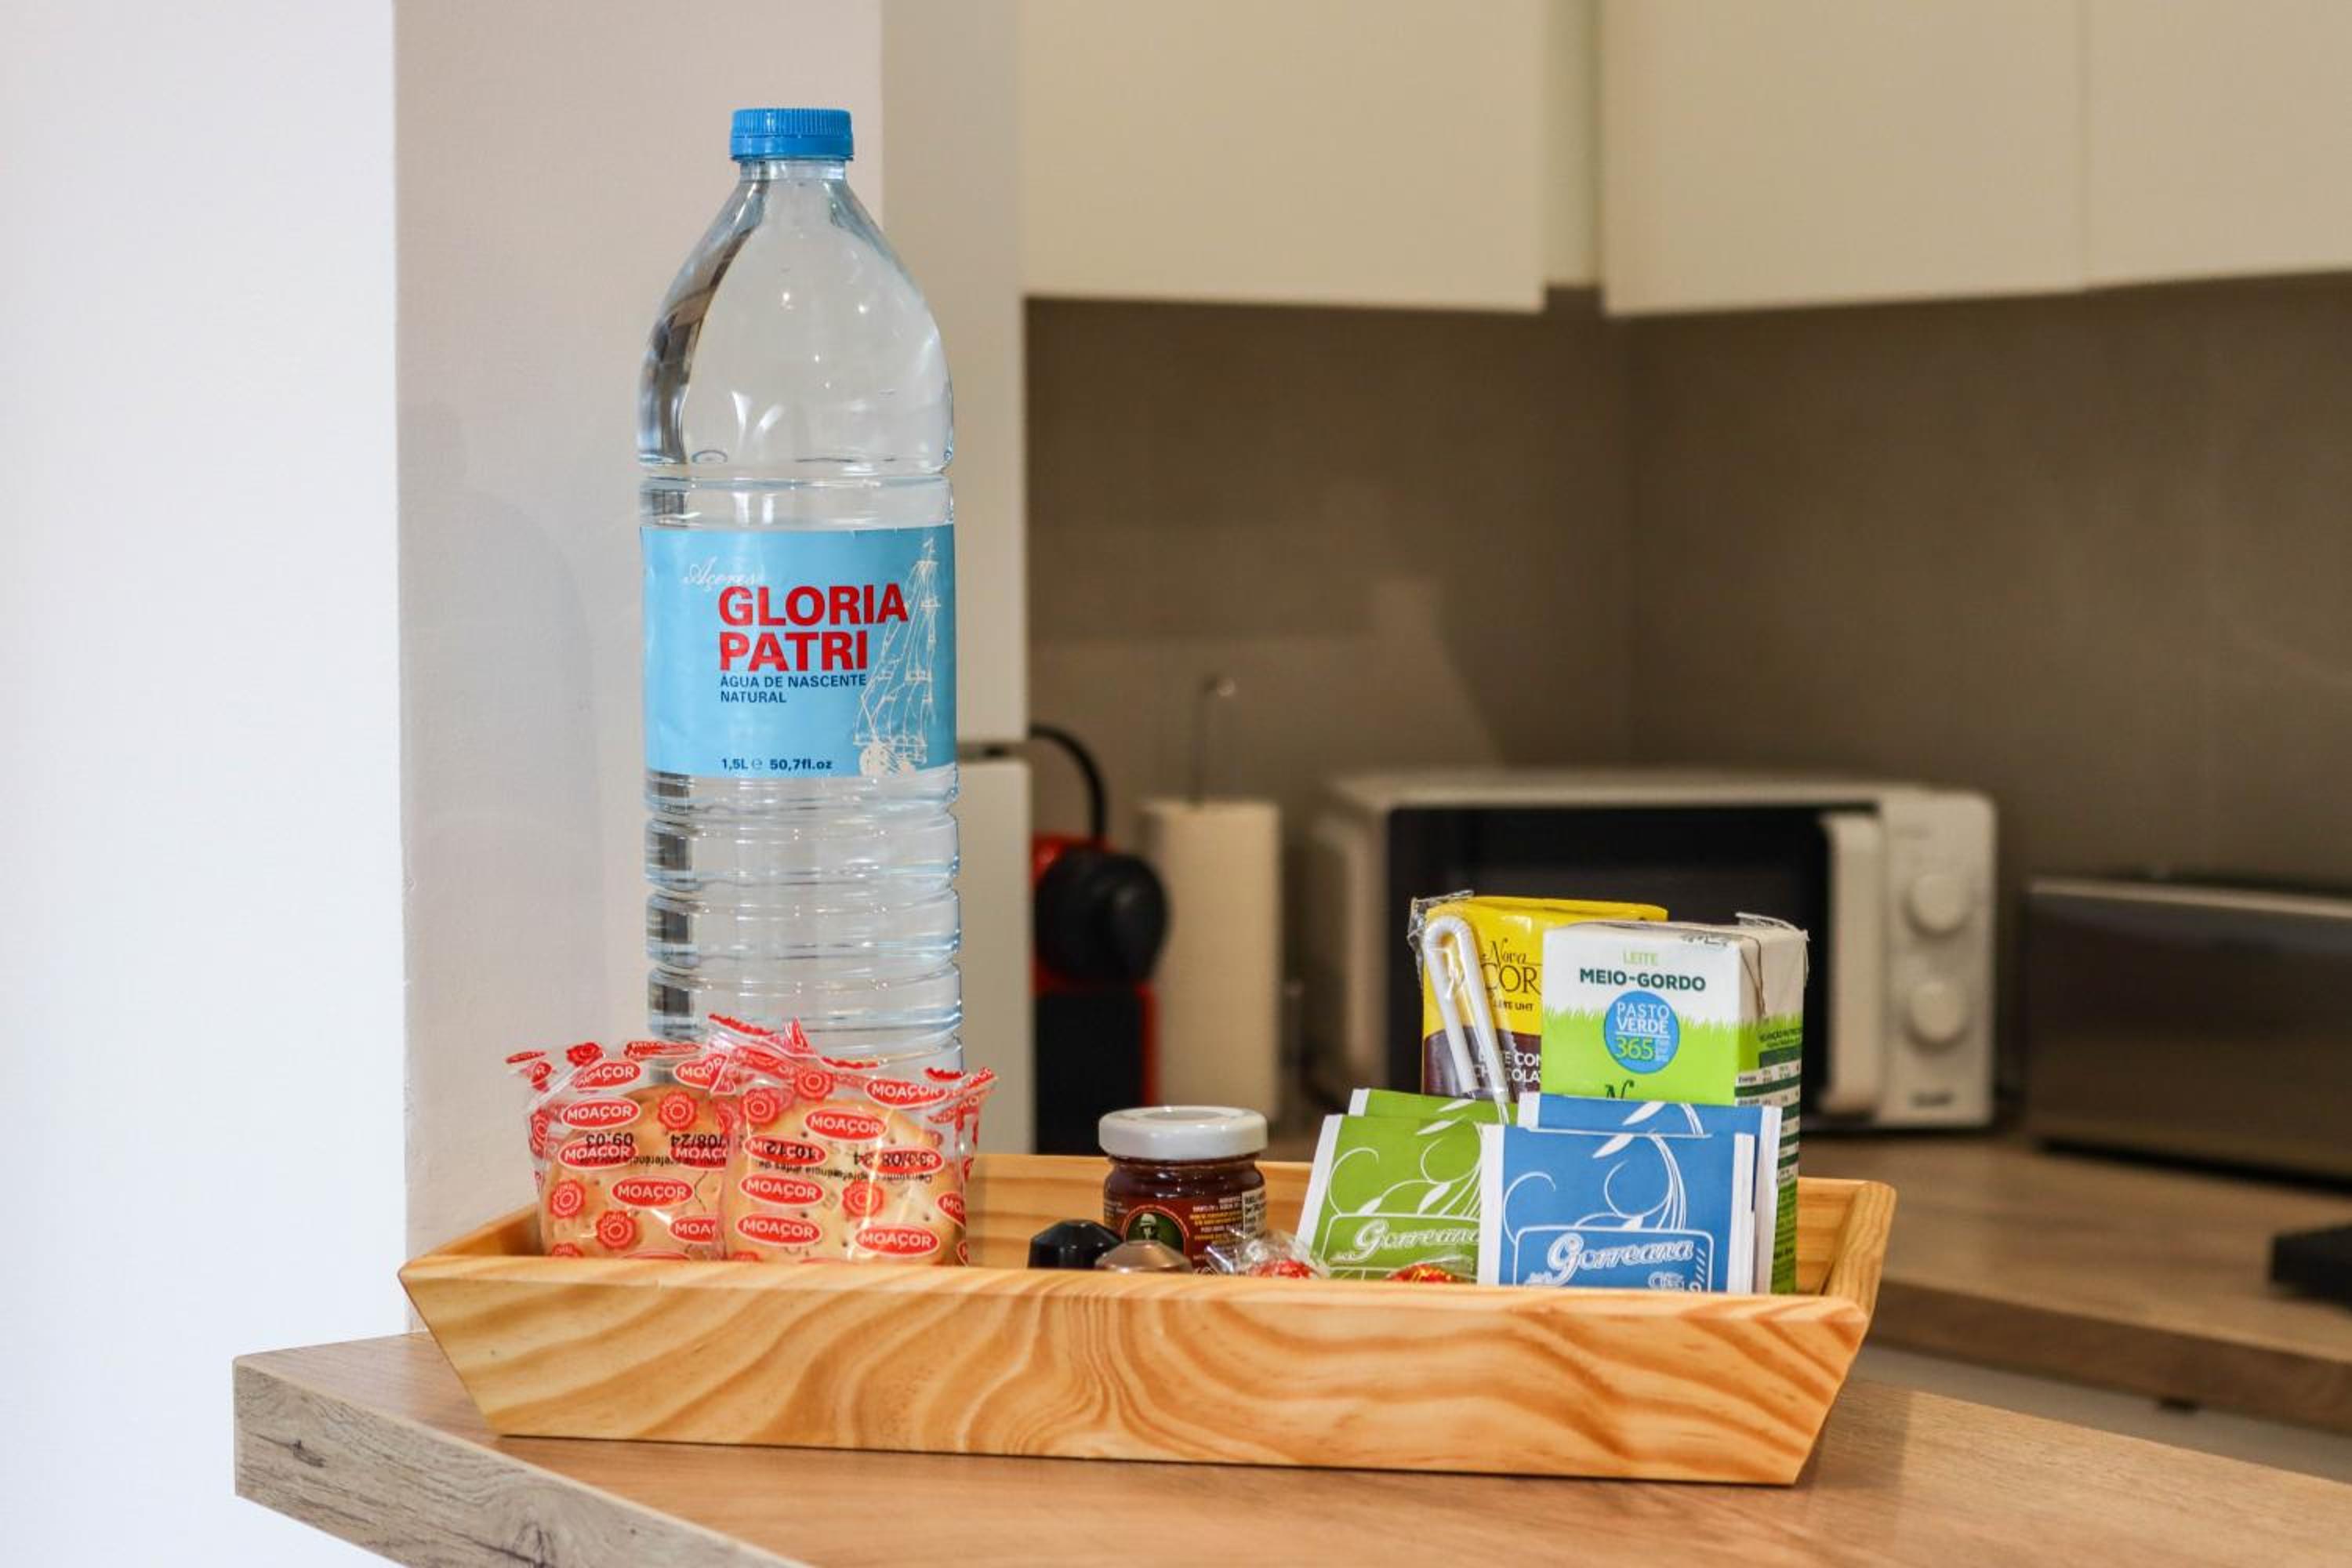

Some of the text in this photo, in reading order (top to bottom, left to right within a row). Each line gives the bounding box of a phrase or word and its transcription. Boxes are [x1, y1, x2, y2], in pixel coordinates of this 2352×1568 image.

[718, 583, 909, 627] GLORIA
[719, 630, 868, 673] PATRI
[720, 673, 867, 688] ÁGUA DE NASCENTE
[720, 691, 787, 703] NATURAL
[721, 757, 750, 771] 1,5L
[1623, 949, 1659, 966] LEITE
[1579, 967, 1707, 992] MEIO-GORDO
[1617, 1001, 1671, 1020] PASTO
[1616, 1016, 1670, 1035] VERDE
[1615, 1035, 1655, 1061] 365
[872, 1083, 940, 1100] MOAÇOR
[567, 1105, 633, 1122] MOAÇOR
[809, 1114, 880, 1134] MOAÇOR
[564, 1145, 630, 1161] MOAÇOR
[617, 1185, 687, 1202] MOAÇOR
[746, 1178, 817, 1200] MOAÇOR
[742, 1219, 814, 1239] MOAÇOR
[862, 1232, 932, 1250] MOAÇOR
